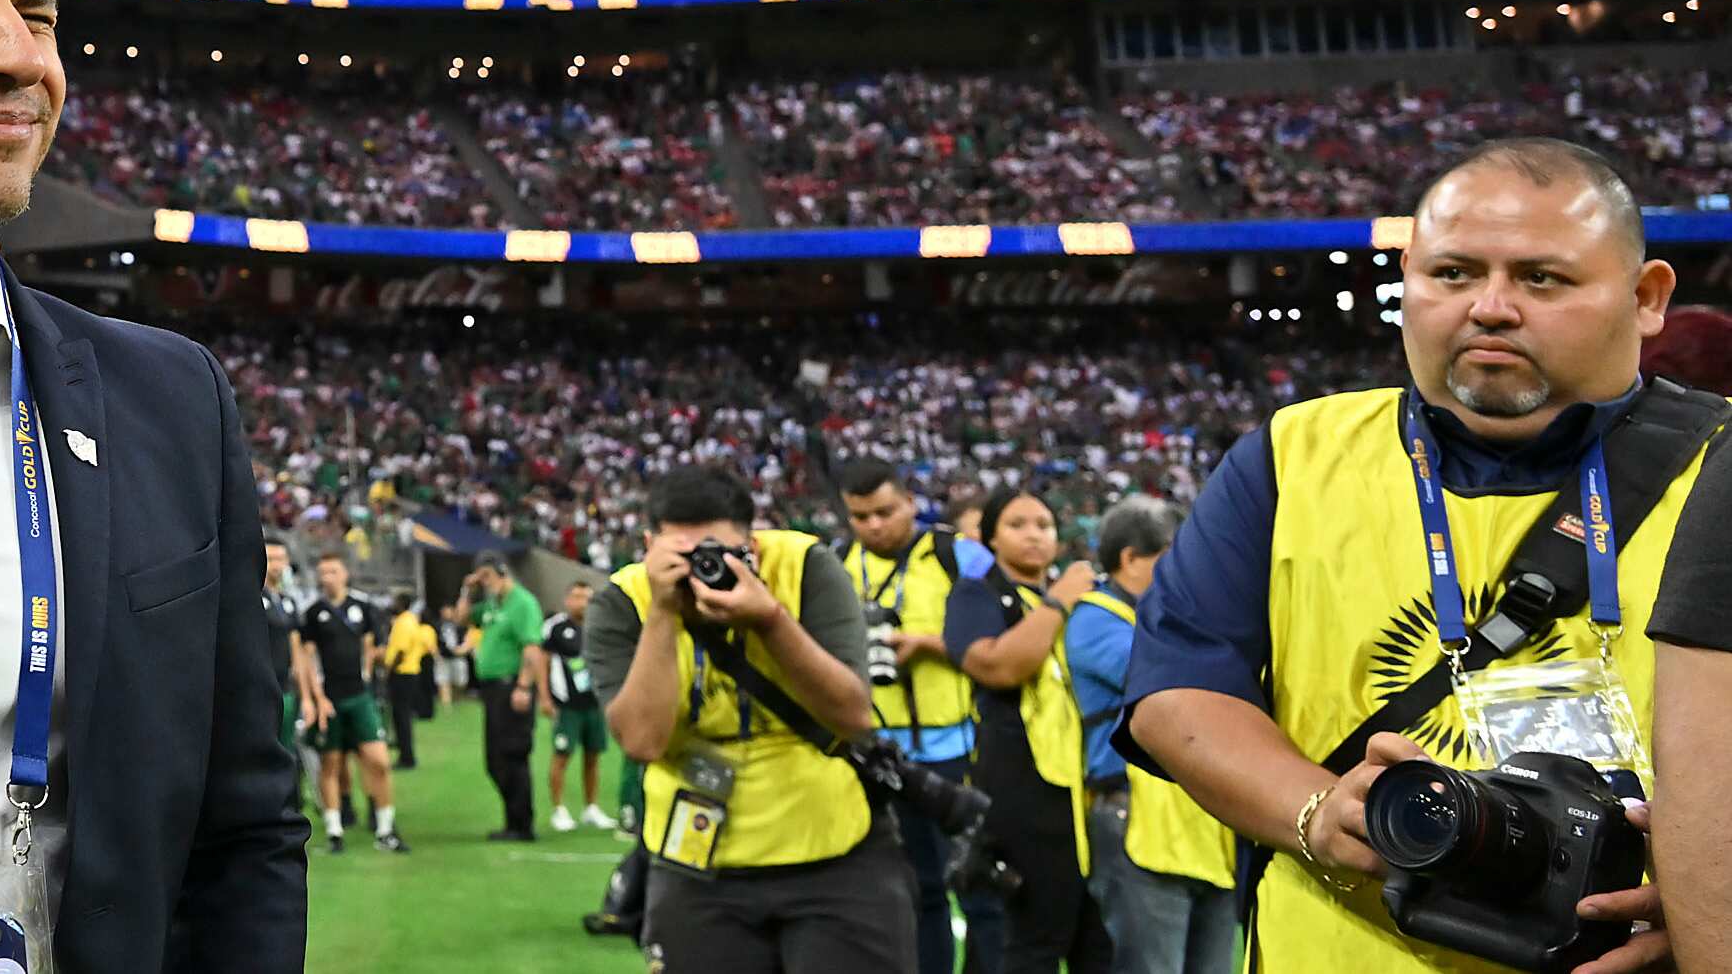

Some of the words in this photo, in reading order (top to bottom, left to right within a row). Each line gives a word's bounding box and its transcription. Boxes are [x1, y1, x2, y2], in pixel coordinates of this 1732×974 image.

[18, 401, 30, 432] CUP
[22, 445, 37, 490] GOLD
[27, 490, 40, 538] Concacaf
[32, 596, 48, 628] OURS
[31, 630, 48, 644] IS
[29, 645, 48, 673] THIS
[1500, 764, 1540, 780] Canon
